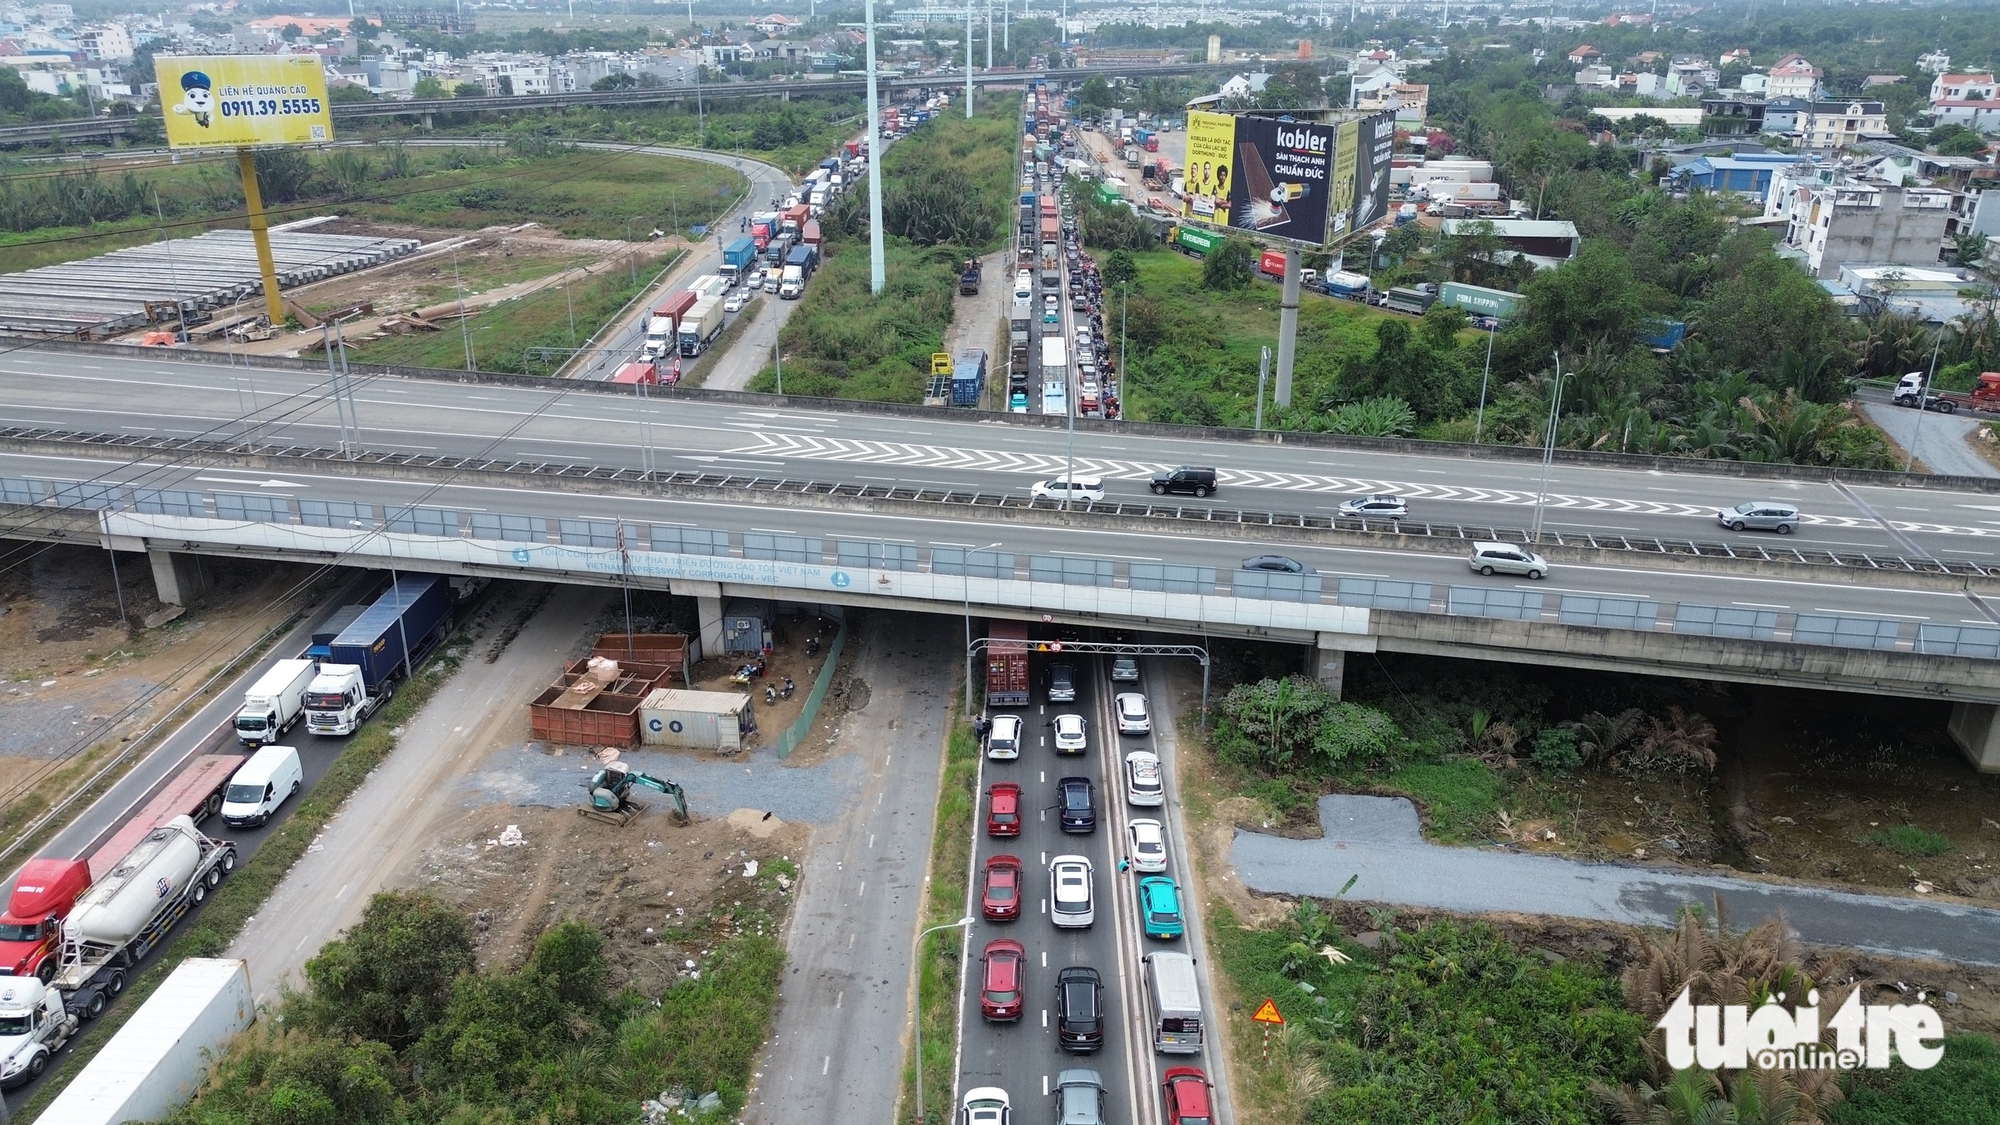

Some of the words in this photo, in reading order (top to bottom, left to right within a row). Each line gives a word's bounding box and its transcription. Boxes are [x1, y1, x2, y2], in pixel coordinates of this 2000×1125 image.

[219, 85, 240, 97] LIÊN
[242, 84, 254, 98] HỆ
[256, 84, 287, 96] QUẢNG
[290, 84, 307, 95] CÁO
[221, 98, 321, 117] 0911.39.5555
[1276, 151, 1288, 161] SÀN
[1289, 154, 1310, 164] THẠCH
[1311, 157, 1325, 166] ANH
[1275, 164, 1304, 176] CHUẨN
[1305, 166, 1324, 179] ĐỨC
[1182, 232, 1211, 248] EVERGREEN
[1456, 294, 1472, 304] CHINA
[688, 570, 754, 580] CORPORATION
[736, 563, 755, 571] CAO
[800, 568, 821, 576] NAM
